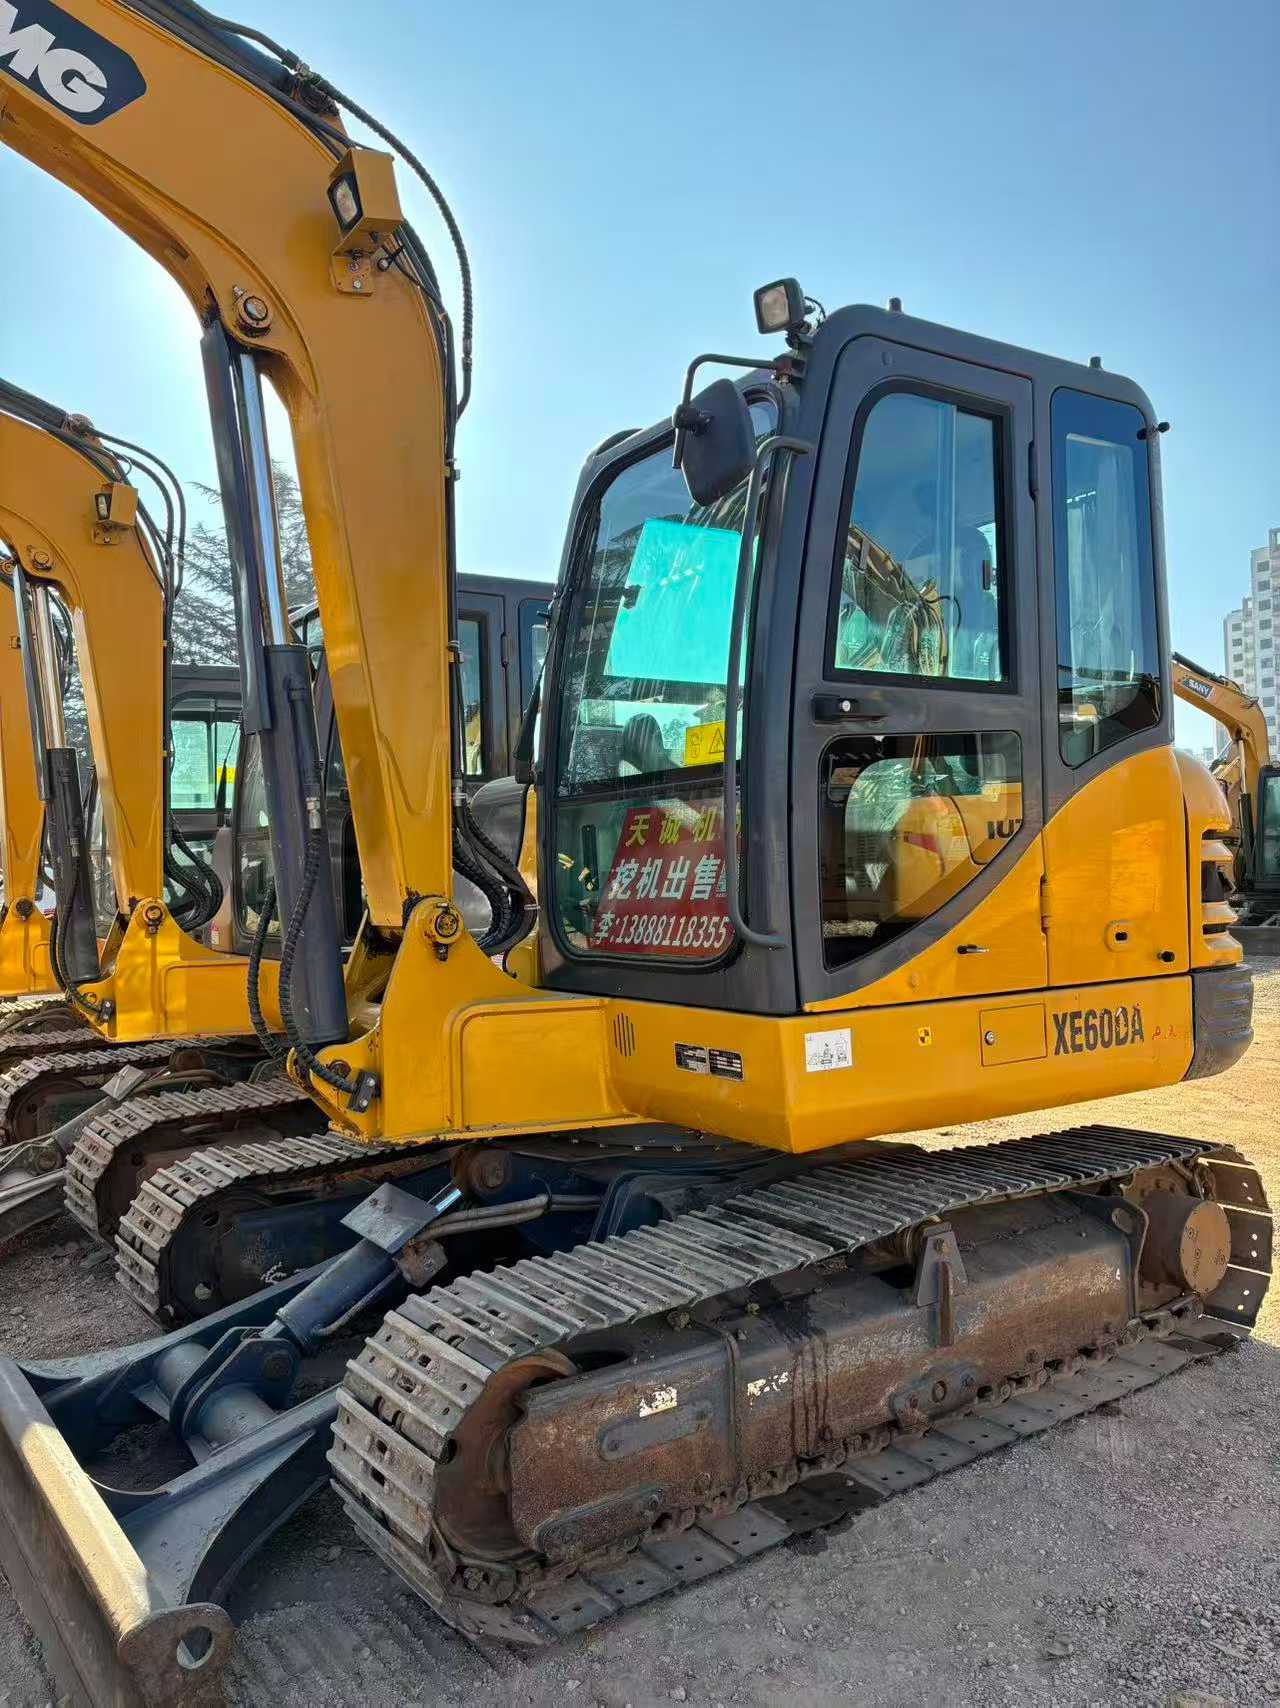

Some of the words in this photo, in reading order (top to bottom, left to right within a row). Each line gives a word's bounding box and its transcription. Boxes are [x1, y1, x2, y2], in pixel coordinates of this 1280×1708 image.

[608, 853, 721, 900] 挖机出售
[1052, 1005, 1146, 1056] XE60DA
